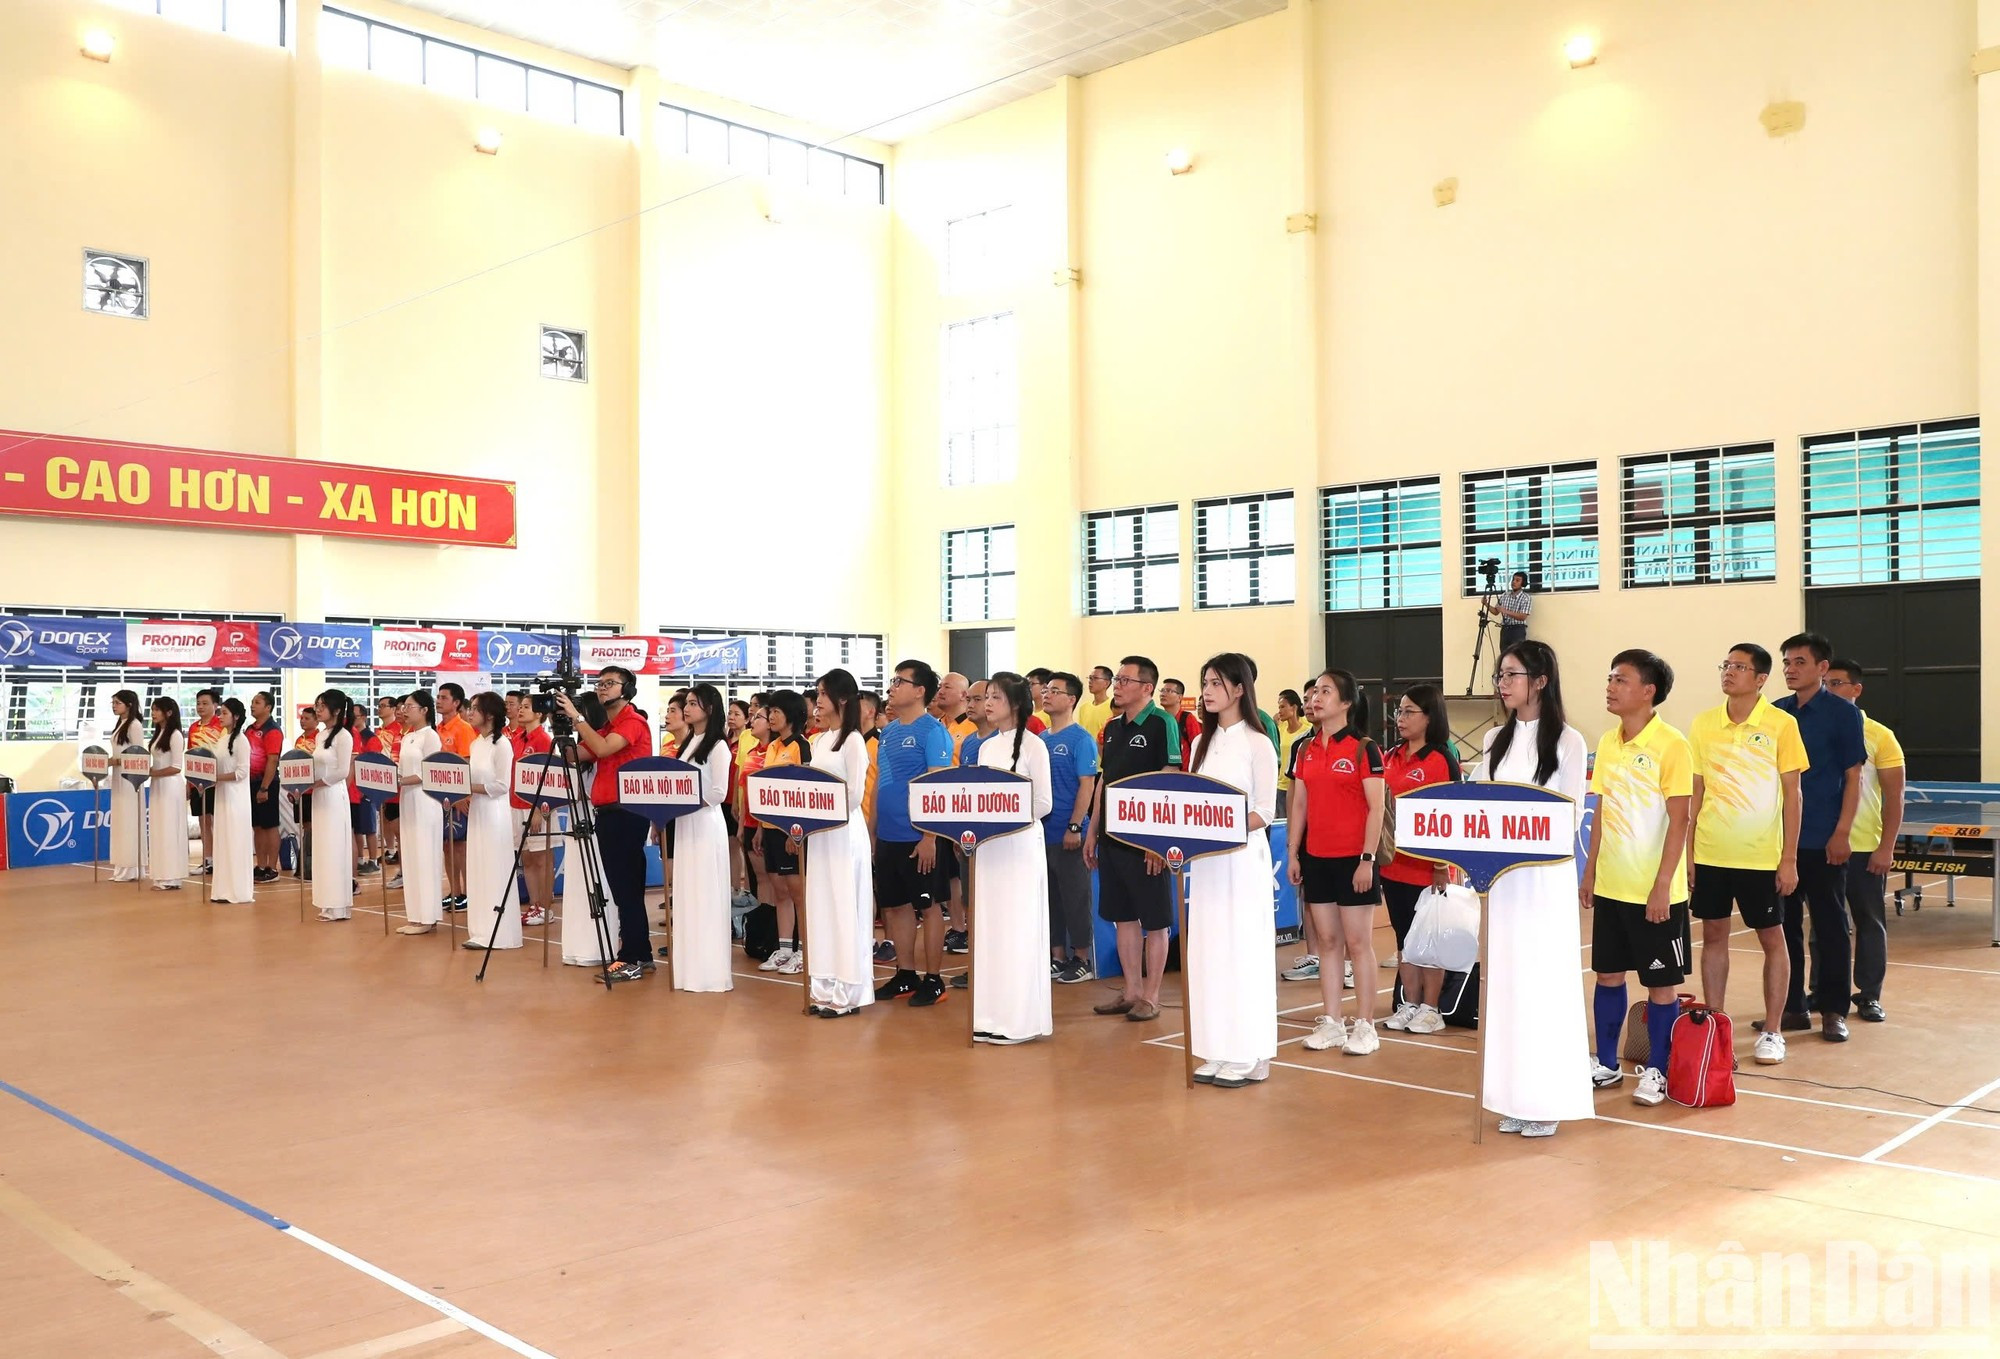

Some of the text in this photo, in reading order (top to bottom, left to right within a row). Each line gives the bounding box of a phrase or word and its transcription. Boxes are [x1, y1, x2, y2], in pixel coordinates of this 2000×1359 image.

[45, 456, 151, 505] CAO
[169, 467, 270, 514] HƠN
[318, 480, 377, 523] XA
[391, 488, 477, 531] HƠN
[39, 631, 112, 645] DONEX
[141, 634, 206, 646] PRONING
[307, 636, 362, 650] DONEX
[75, 645, 109, 656] Sport
[384, 640, 437, 652] PRONING
[591, 647, 641, 658] PRONING
[335, 649, 360, 659] Sport
[430, 767, 464, 788] TRỌNG TÀI
[521, 768, 535, 785] BÁO
[623, 775, 693, 798] BÁO HÀ NỘI MỚI
[759, 785, 835, 811] BÁO THÁI BÌNH
[922, 787, 1020, 814] BÁO HẢI DƯƠNG
[1118, 795, 1234, 828] BÁO HẢI PHÒNG
[1413, 808, 1551, 841] BÁO HÀ NAM
[1890, 859, 1967, 873] OUBLE FISH
